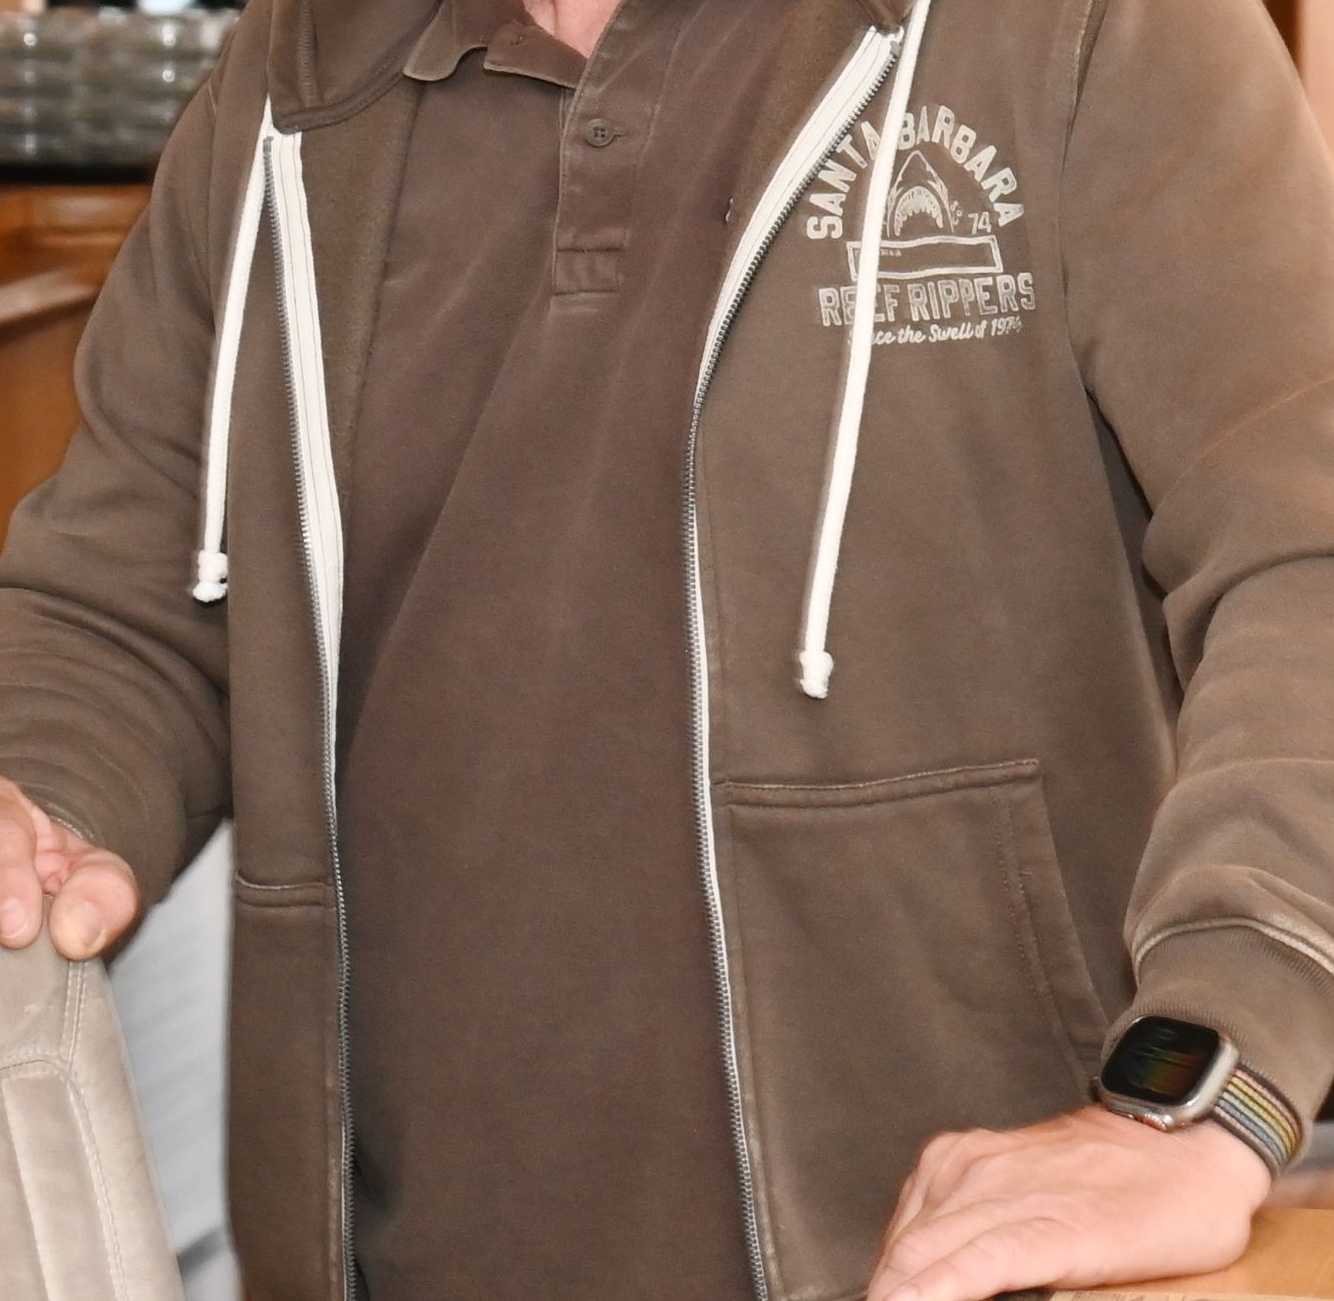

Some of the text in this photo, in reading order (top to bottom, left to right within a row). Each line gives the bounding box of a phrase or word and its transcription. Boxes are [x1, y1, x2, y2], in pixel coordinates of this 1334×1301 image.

[806, 105, 1024, 239] SANTA BARBARA
[968, 211, 991, 235] 74
[907, 272, 1036, 322] RIPPERS
[897, 325, 926, 345] the
[929, 322, 974, 343] Swell
[975, 320, 987, 339] of
